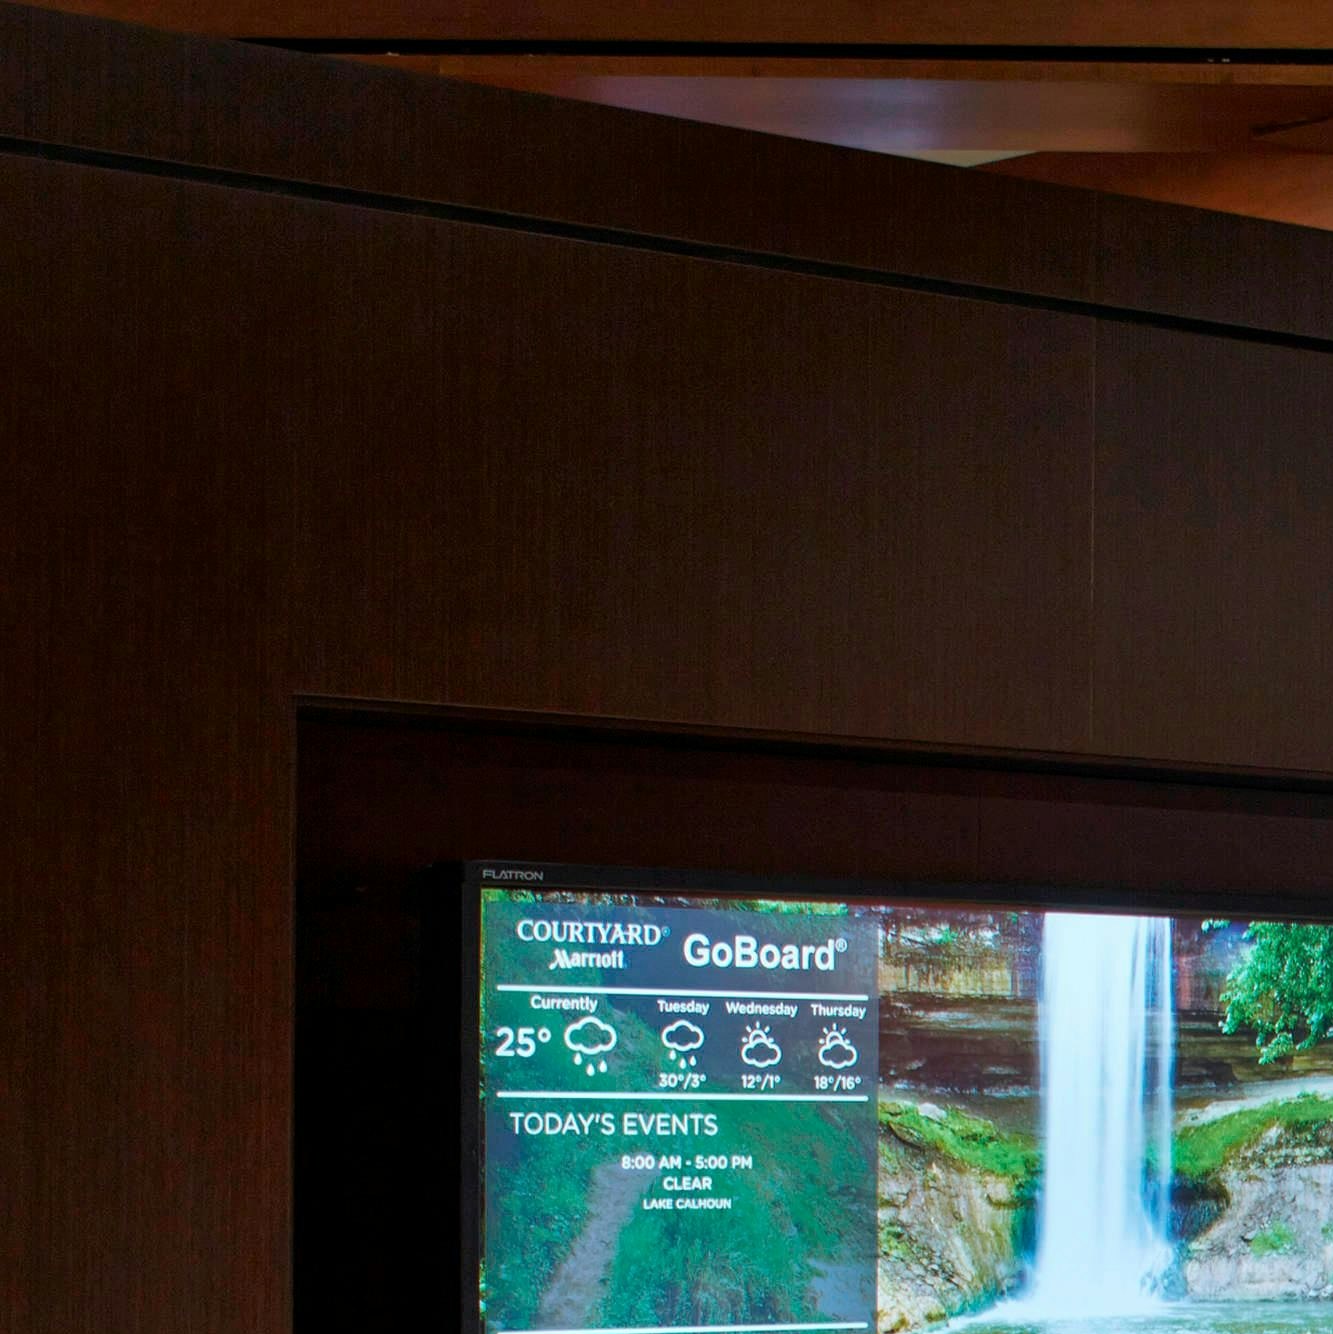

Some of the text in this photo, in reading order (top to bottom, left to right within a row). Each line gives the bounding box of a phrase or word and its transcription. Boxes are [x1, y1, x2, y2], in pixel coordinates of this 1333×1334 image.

[482, 869, 544, 881] FLATRON
[548, 948, 625, 970] Marriott
[530, 995, 598, 1013] Currently
[656, 999, 711, 1016] Tuesday
[725, 1001, 799, 1018] Wednesday
[810, 1003, 867, 1020] Thursday
[495, 1026, 552, 1058] 25°
[509, 1112, 719, 1137] TODAY'S EVENTS
[621, 1155, 655, 1170] 8:00
[658, 1156, 682, 1170] AM
[695, 1156, 728, 1170] 5:00
[731, 1156, 753, 1170] PM
[663, 1176, 713, 1191] CLEAR
[643, 1198, 732, 1210] LAKE CALHOUN
